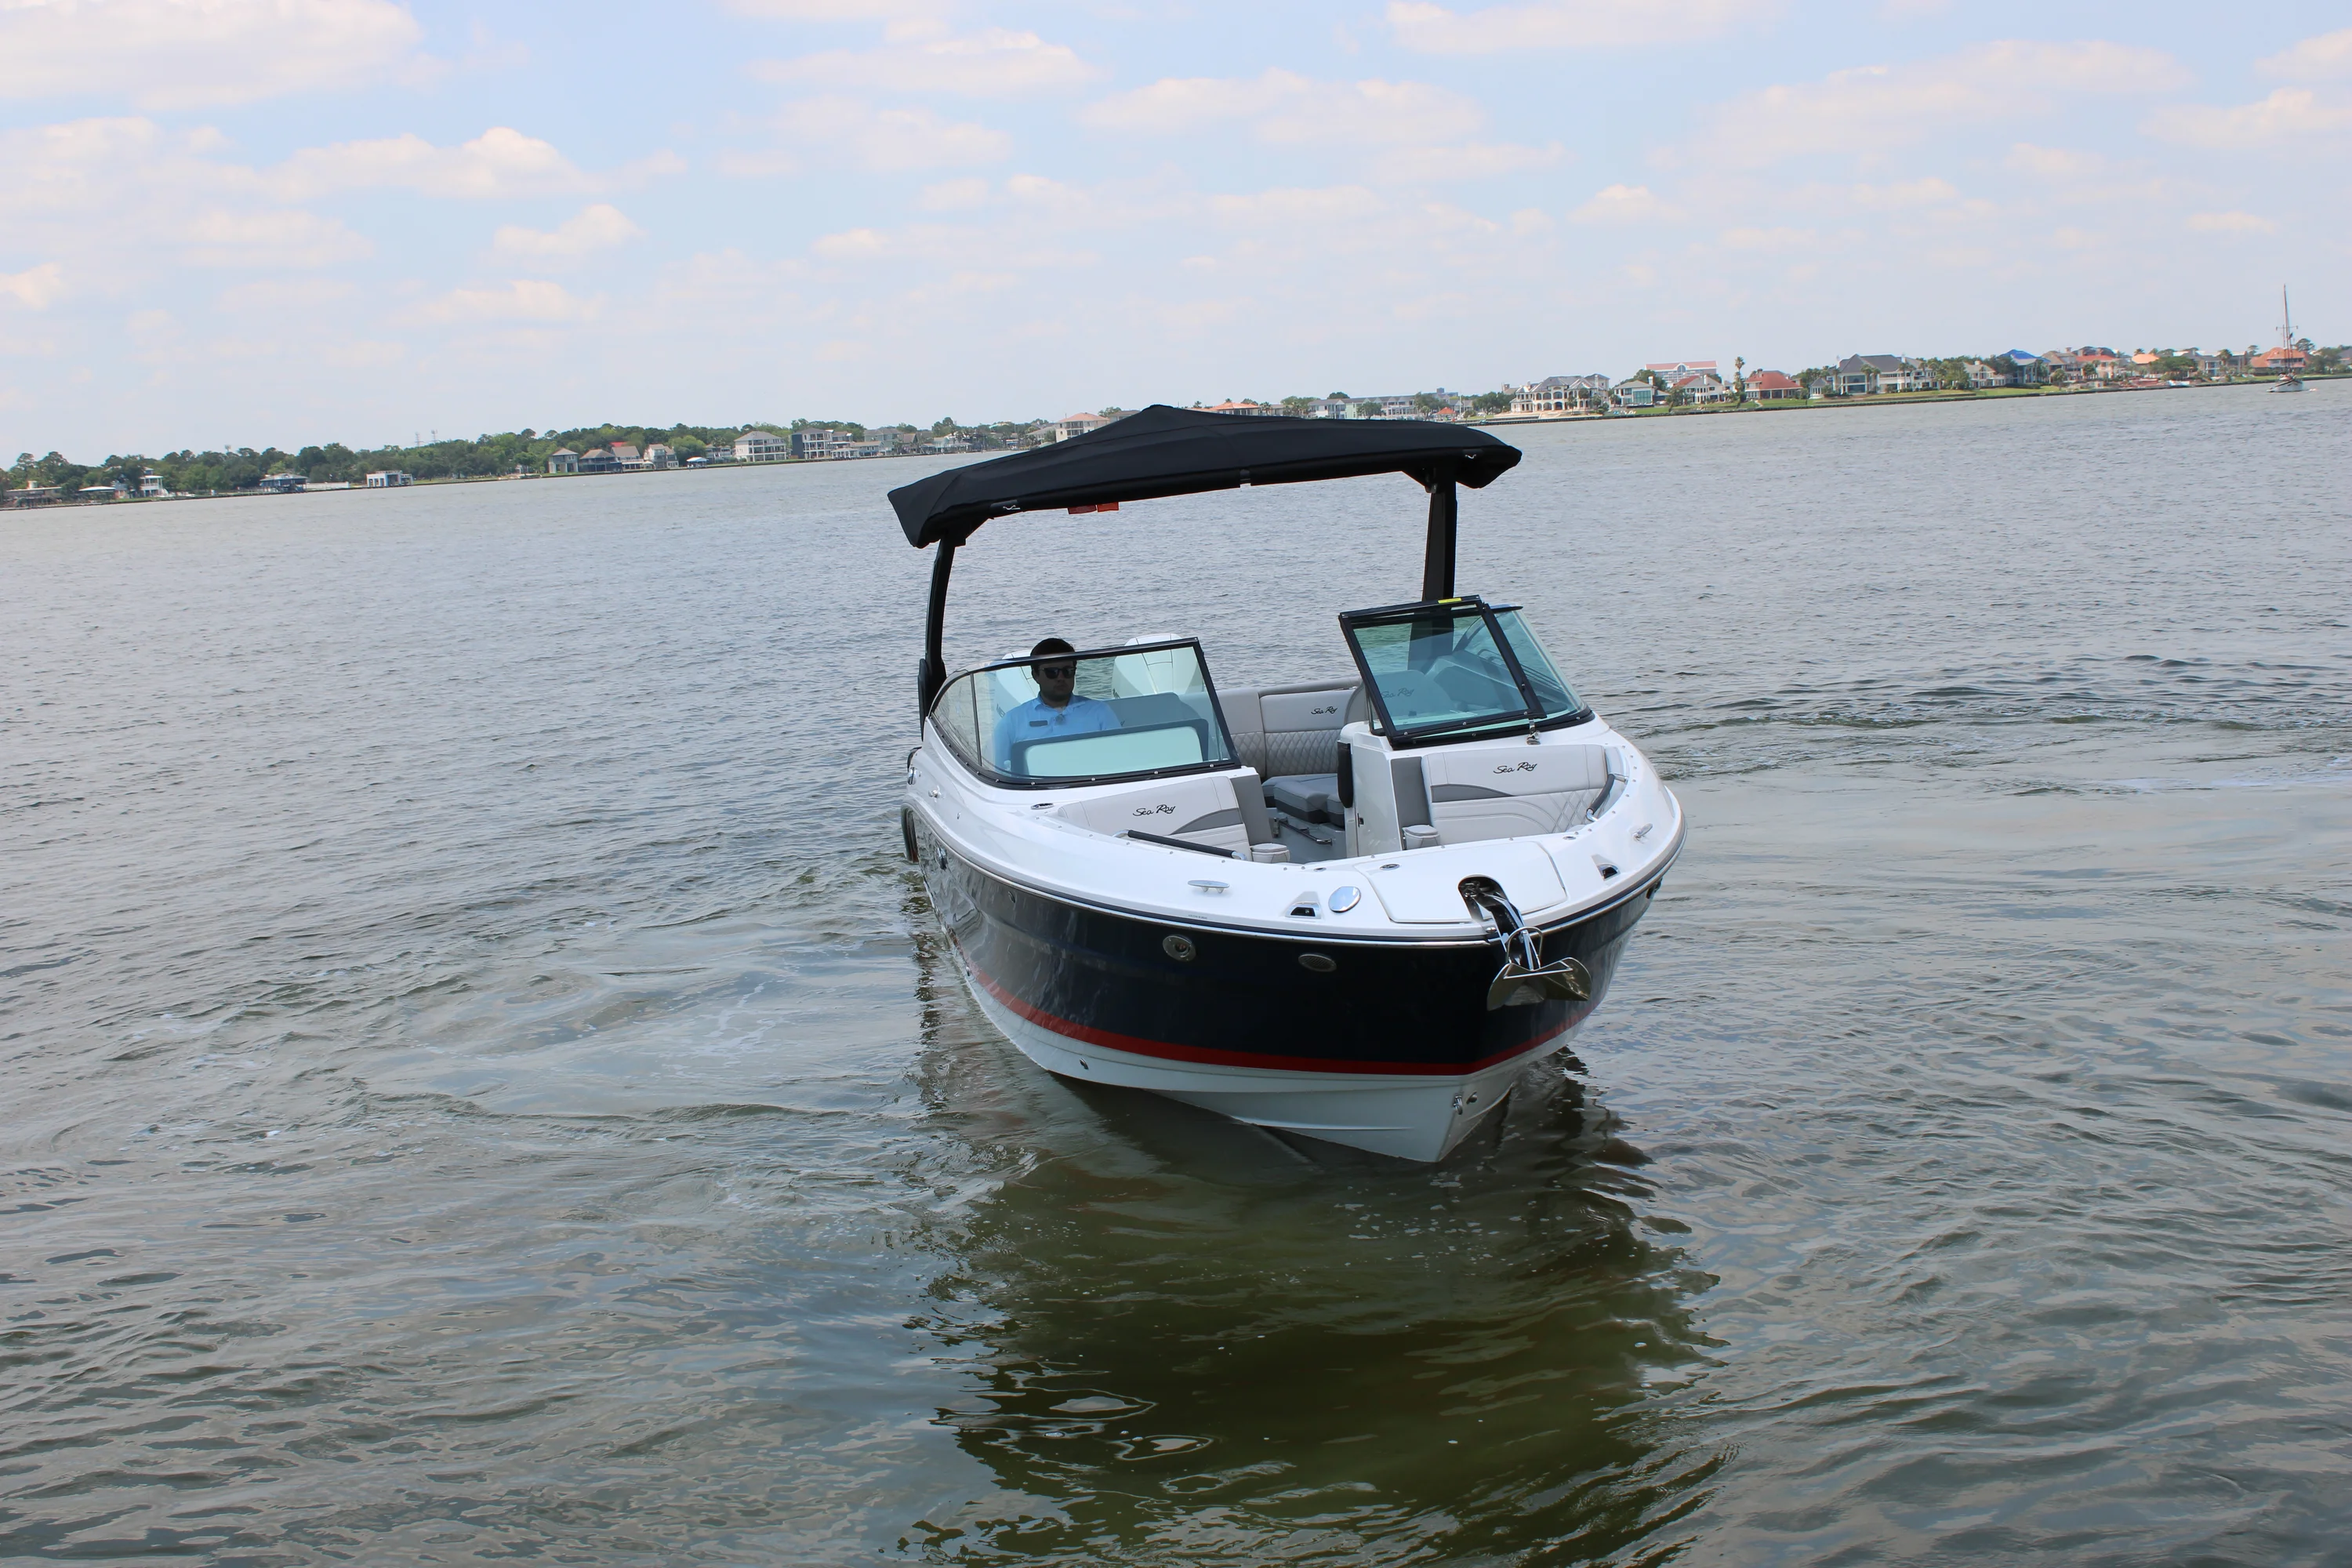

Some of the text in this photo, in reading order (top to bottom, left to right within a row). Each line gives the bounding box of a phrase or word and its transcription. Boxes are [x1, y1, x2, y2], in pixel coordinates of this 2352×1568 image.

[1325, 706, 1338, 714] Ray
[1493, 761, 1537, 775] Sea Ray
[1132, 804, 1176, 817] Sea Ray
